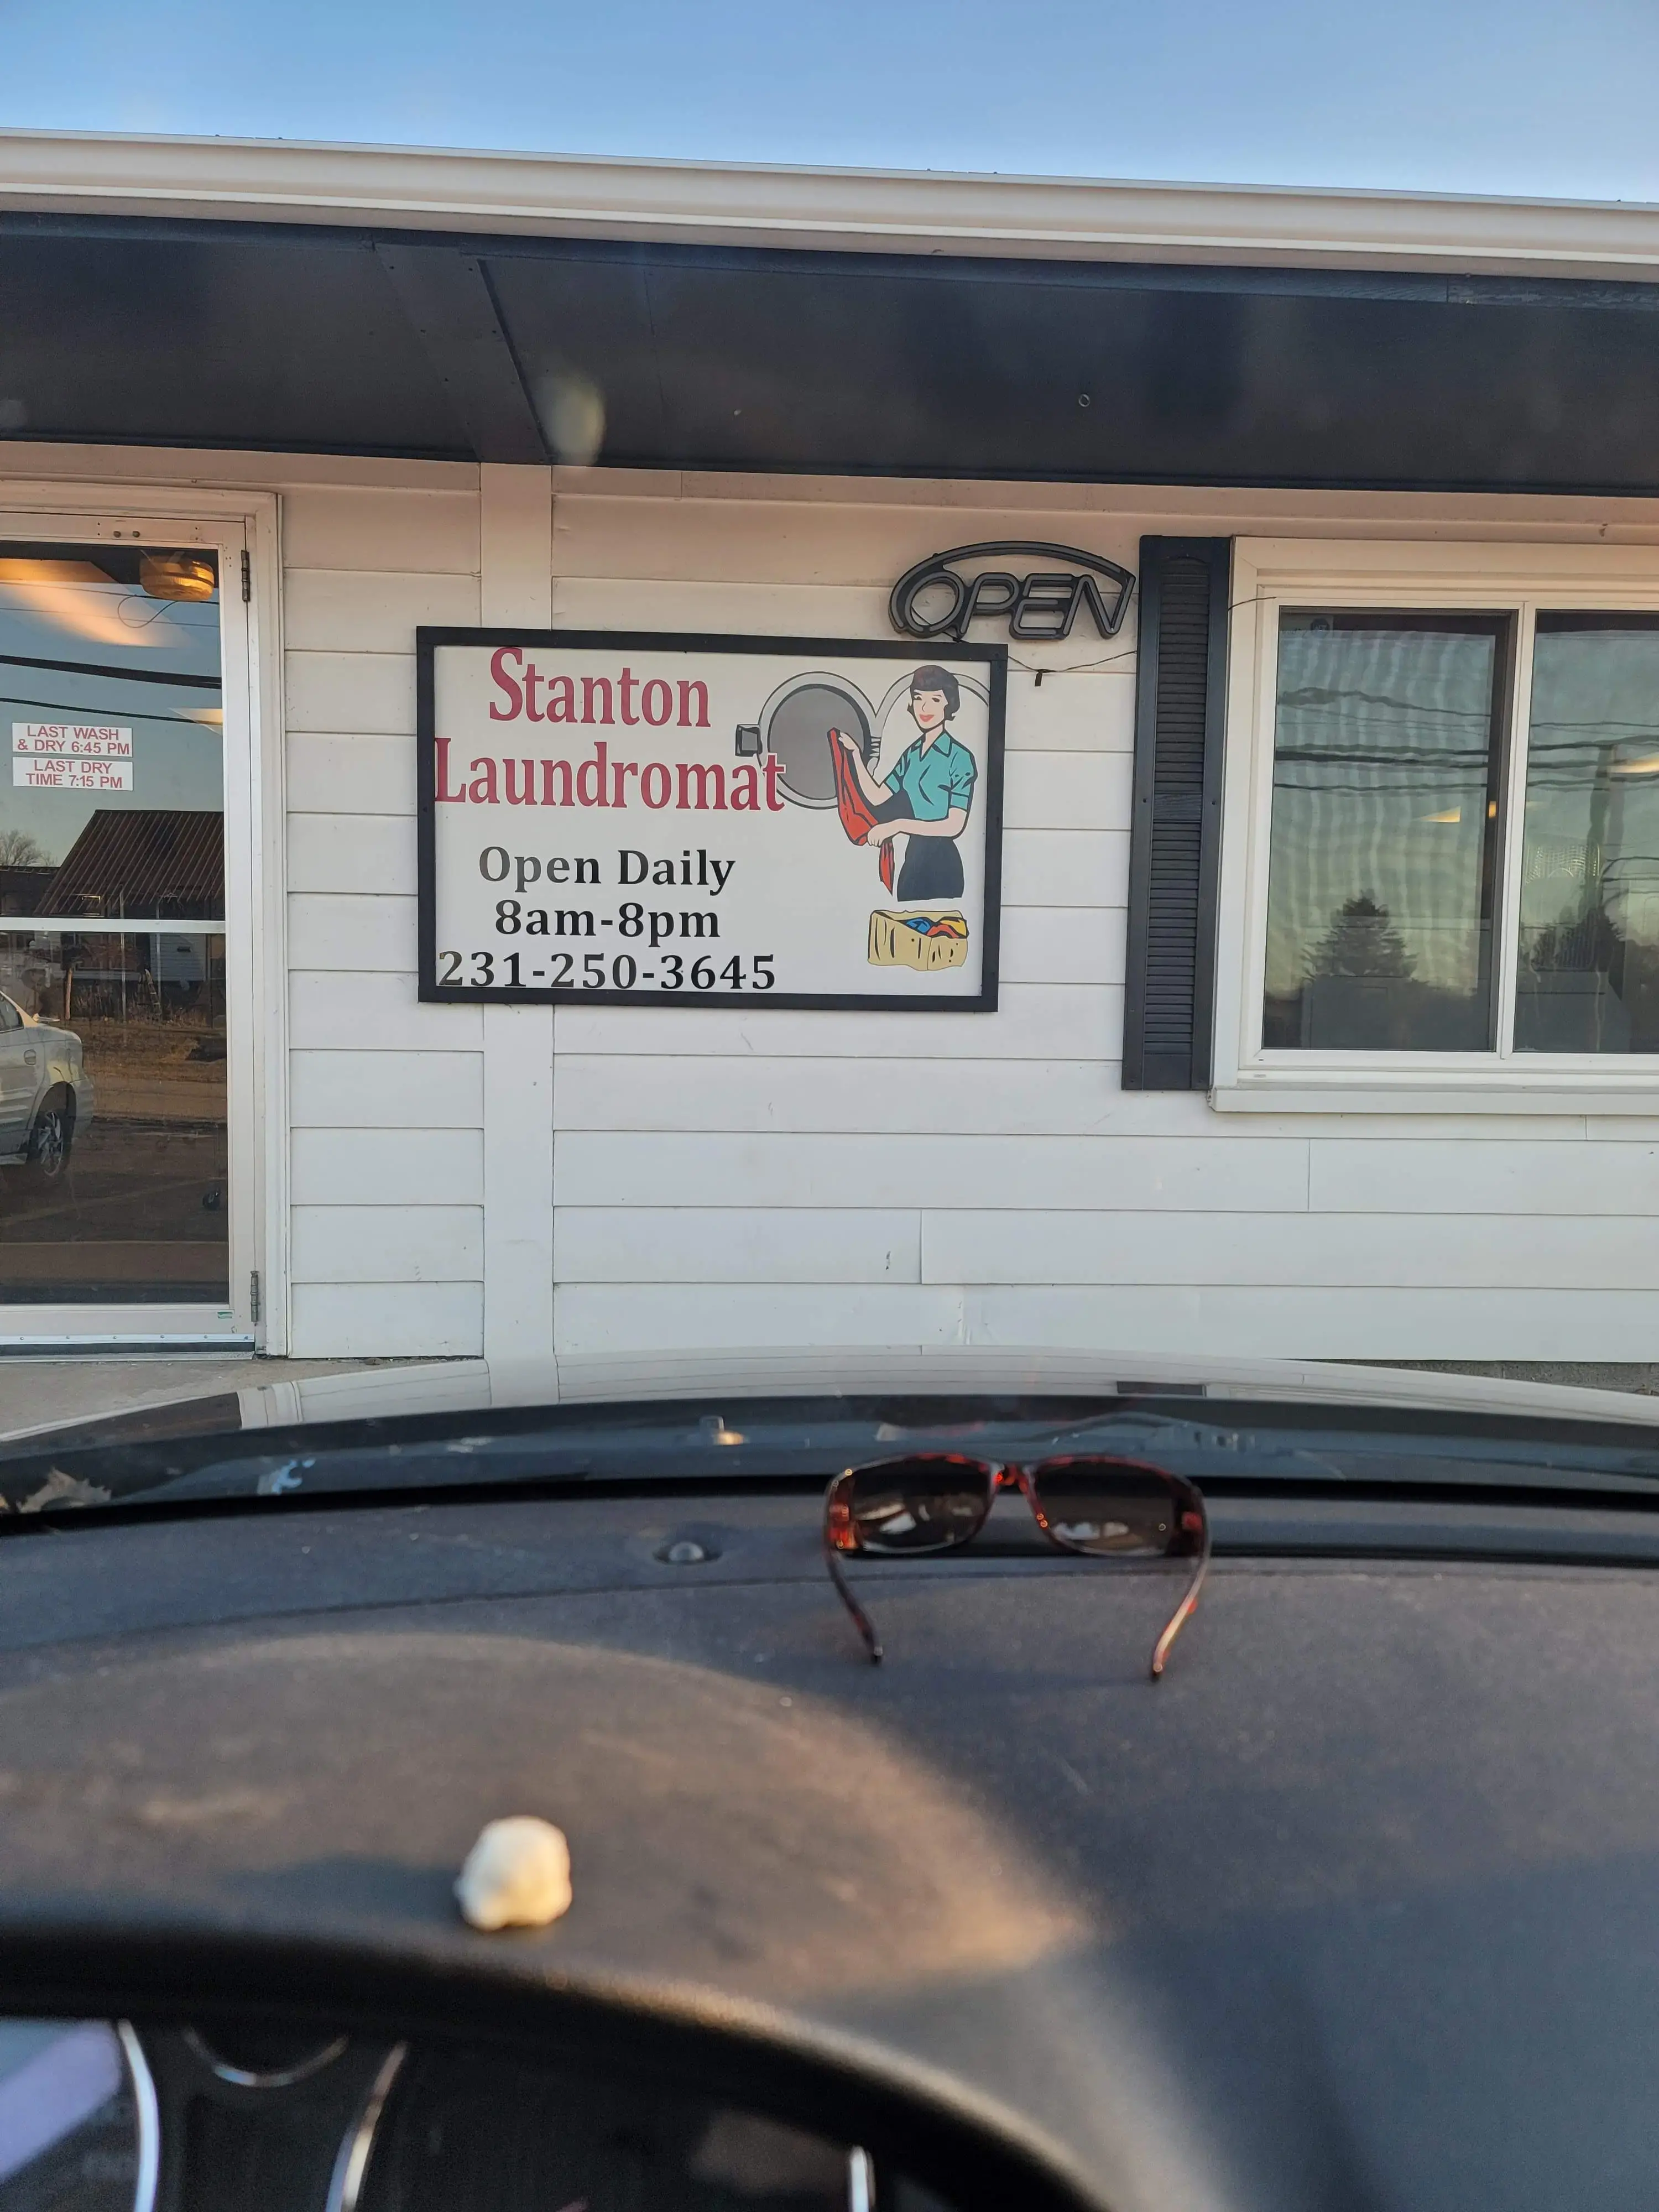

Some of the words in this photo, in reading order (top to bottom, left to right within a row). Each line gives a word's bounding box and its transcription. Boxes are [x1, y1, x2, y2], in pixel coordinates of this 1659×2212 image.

[904, 571, 1136, 639] OPEN
[489, 646, 711, 728] Stanton
[17, 738, 28, 750] &
[34, 739, 66, 752] DRY
[71, 741, 101, 754] 6:45
[107, 743, 129, 754] PM
[27, 725, 68, 738] LAST
[74, 727, 119, 740] WASH
[26, 773, 63, 786] TIME
[69, 775, 94, 787] 7:15
[100, 776, 122, 789] PM
[34, 759, 76, 773] LAST
[81, 761, 113, 774] DRY
[434, 737, 785, 811] Laundromat
[479, 846, 602, 893] Open
[618, 849, 736, 896] Daily
[495, 899, 721, 948] 8am-8pm
[439, 951, 775, 990] 231-250-3645
